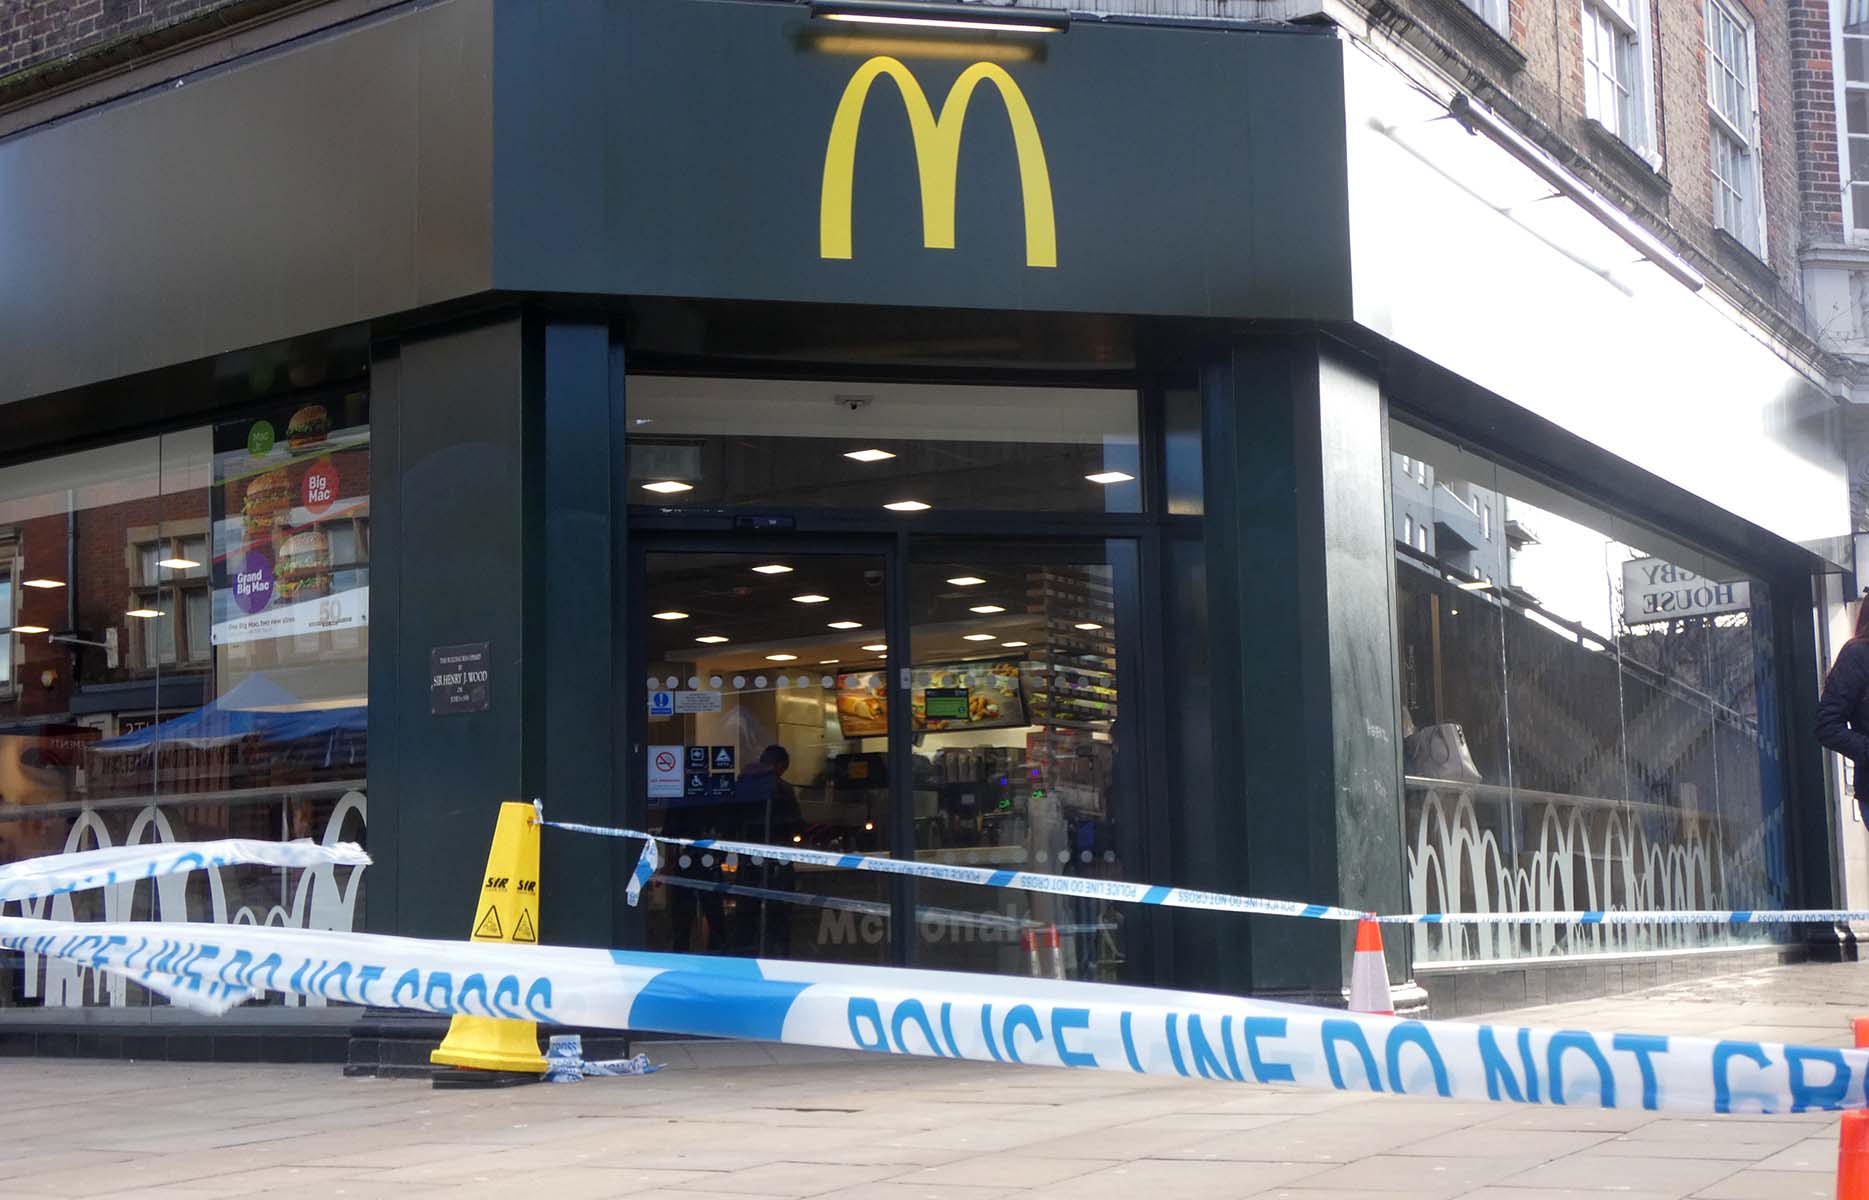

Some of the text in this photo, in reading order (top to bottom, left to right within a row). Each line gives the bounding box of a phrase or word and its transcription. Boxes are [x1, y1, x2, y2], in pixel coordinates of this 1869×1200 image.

[308, 475, 327, 491] Big
[308, 489, 330, 503] Mac
[237, 569, 263, 583] Grand
[237, 581, 270, 595] Big Mac
[468, 670, 488, 683] WOOD
[391, 967, 563, 1024] CROSS
[847, 996, 1100, 1069] POLICE
[1120, 1010, 1297, 1085] LINE
[1321, 1018, 1453, 1098] DO
[1478, 1024, 1670, 1111] NOT
[1712, 1039, 1869, 1114] CR
